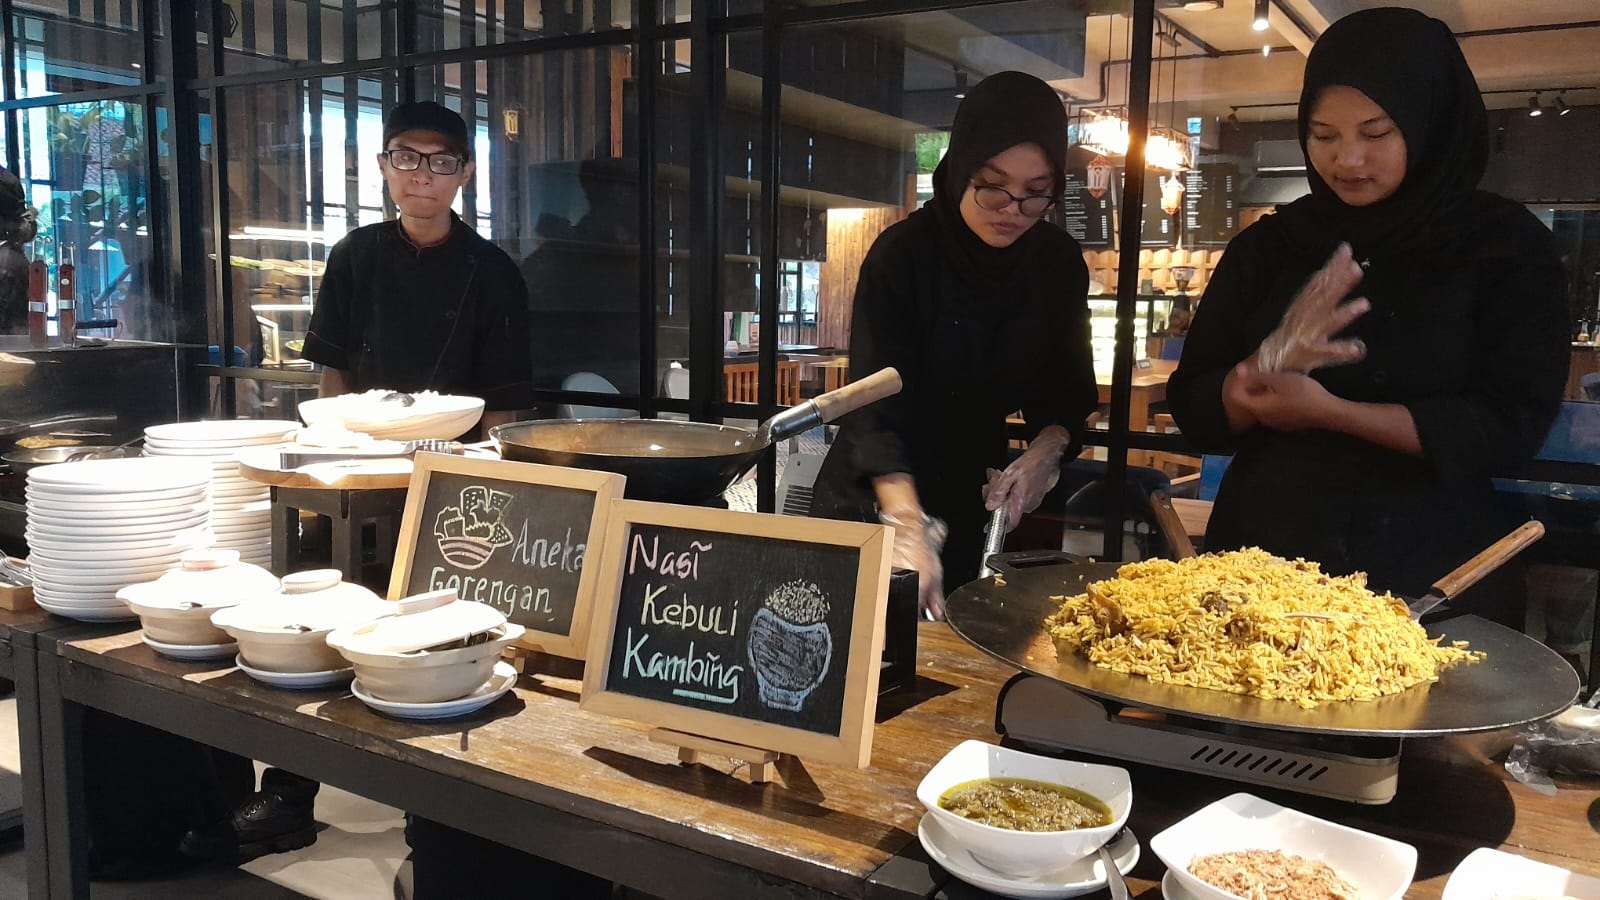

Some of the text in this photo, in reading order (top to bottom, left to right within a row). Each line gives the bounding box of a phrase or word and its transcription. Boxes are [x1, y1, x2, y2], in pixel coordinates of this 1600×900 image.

[512, 518, 586, 573] Aneka
[628, 533, 713, 580] Nasi
[428, 566, 553, 618] Gorengan
[622, 627, 743, 703] Kambing
